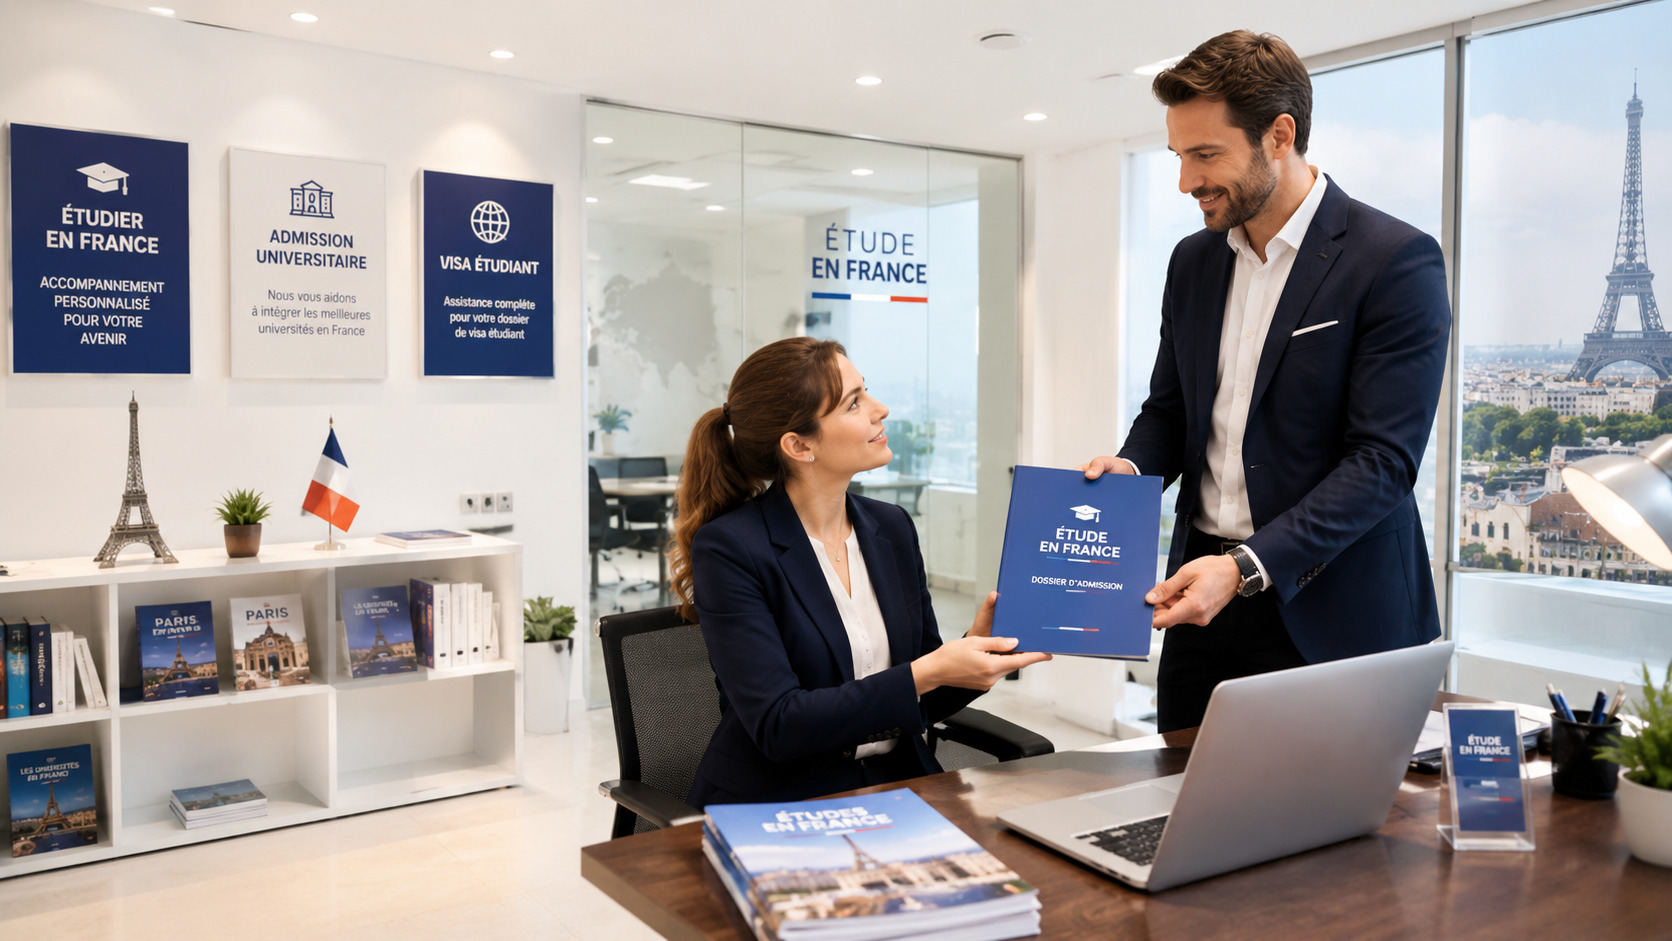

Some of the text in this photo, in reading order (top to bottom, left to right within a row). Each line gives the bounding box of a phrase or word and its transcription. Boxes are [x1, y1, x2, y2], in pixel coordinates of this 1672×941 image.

[62, 203, 144, 229] ÉTUDIER
[46, 230, 159, 254] EN FRANCE
[269, 229, 354, 249] ADMISSION
[826, 222, 914, 256] ÉTUDE
[256, 249, 367, 269] UNIVERSITAIRE
[440, 254, 540, 275] VISA ÉTUDIANT
[812, 257, 927, 284] EN FRANCE
[40, 276, 165, 293] ACCOMPANNEMENT
[54, 295, 151, 310] PERSONNALISÉ
[268, 289, 357, 304] Nous vous aidons
[443, 295, 493, 308] Assistance
[261, 305, 302, 320] intégrer
[304, 308, 318, 319] les
[321, 308, 371, 321] meilleures
[449, 313, 471, 324] pour
[473, 313, 496, 324] votre
[64, 314, 143, 328] POUR VOTRE
[258, 323, 366, 336] universités en France
[455, 326, 525, 340] de visa étudiant
[80, 332, 127, 345] AVENIR
[1056, 526, 1108, 543] ÉTUDE
[1040, 541, 1121, 558] EN FRANCE
[1031, 576, 1067, 586] DOSSIER
[155, 615, 198, 627] PARIS
[246, 607, 289, 621] PARIS
[1468, 733, 1502, 746] ÉTUDE
[1459, 745, 1511, 755] EN FRANCE
[775, 806, 868, 823] ÉTUDES
[762, 813, 893, 832] EN FRANCE
